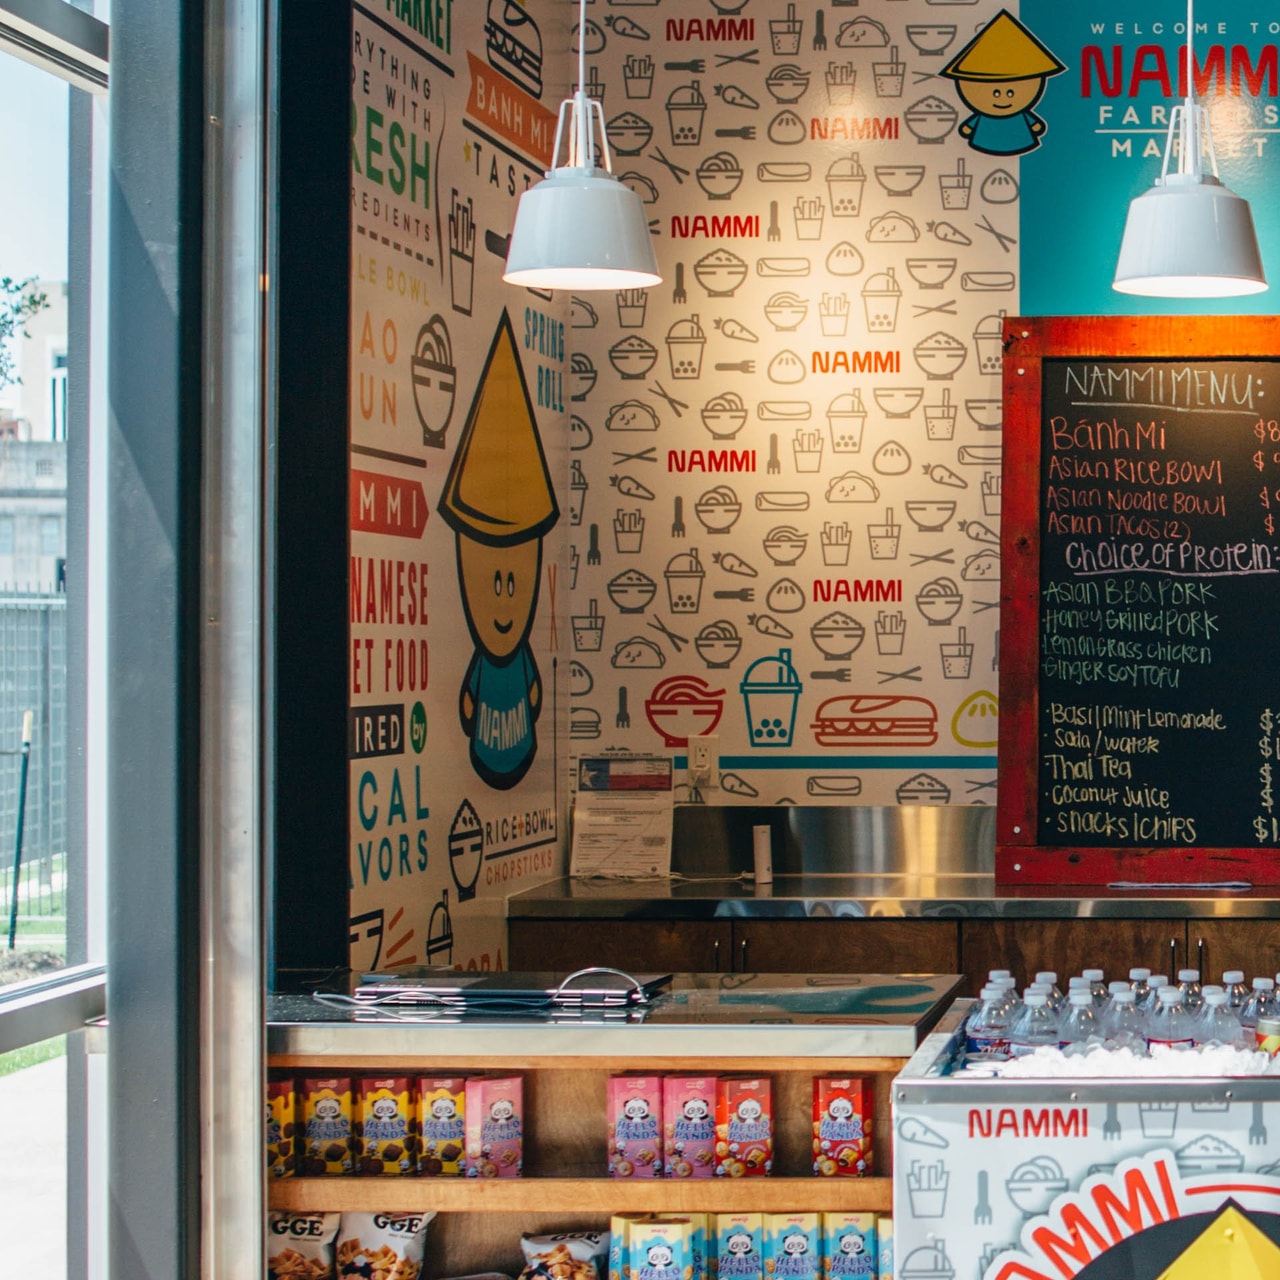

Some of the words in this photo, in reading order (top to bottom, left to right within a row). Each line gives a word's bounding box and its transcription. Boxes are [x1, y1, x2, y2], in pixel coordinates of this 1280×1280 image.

[665, 17, 756, 42] NAMMI
[1091, 22, 1227, 35] WELCOME
[1250, 22, 1280, 34] TO
[476, 76, 523, 137] BANH
[530, 121, 548, 154] MI
[810, 117, 900, 140] NAMMI
[670, 215, 760, 239] NAMMI
[524, 306, 565, 363] SPRING
[811, 350, 901, 374] NAMMI
[537, 364, 565, 413] ROLL
[1065, 366, 1164, 402] NAMMI
[667, 449, 757, 473] NAMMI
[812, 579, 903, 603] NAMMI
[384, 638, 429, 693] FOOD
[478, 697, 529, 752] NAMMI
[485, 849, 553, 887] CHOPSTICKS
[969, 1108, 1088, 1138] NAMMI
